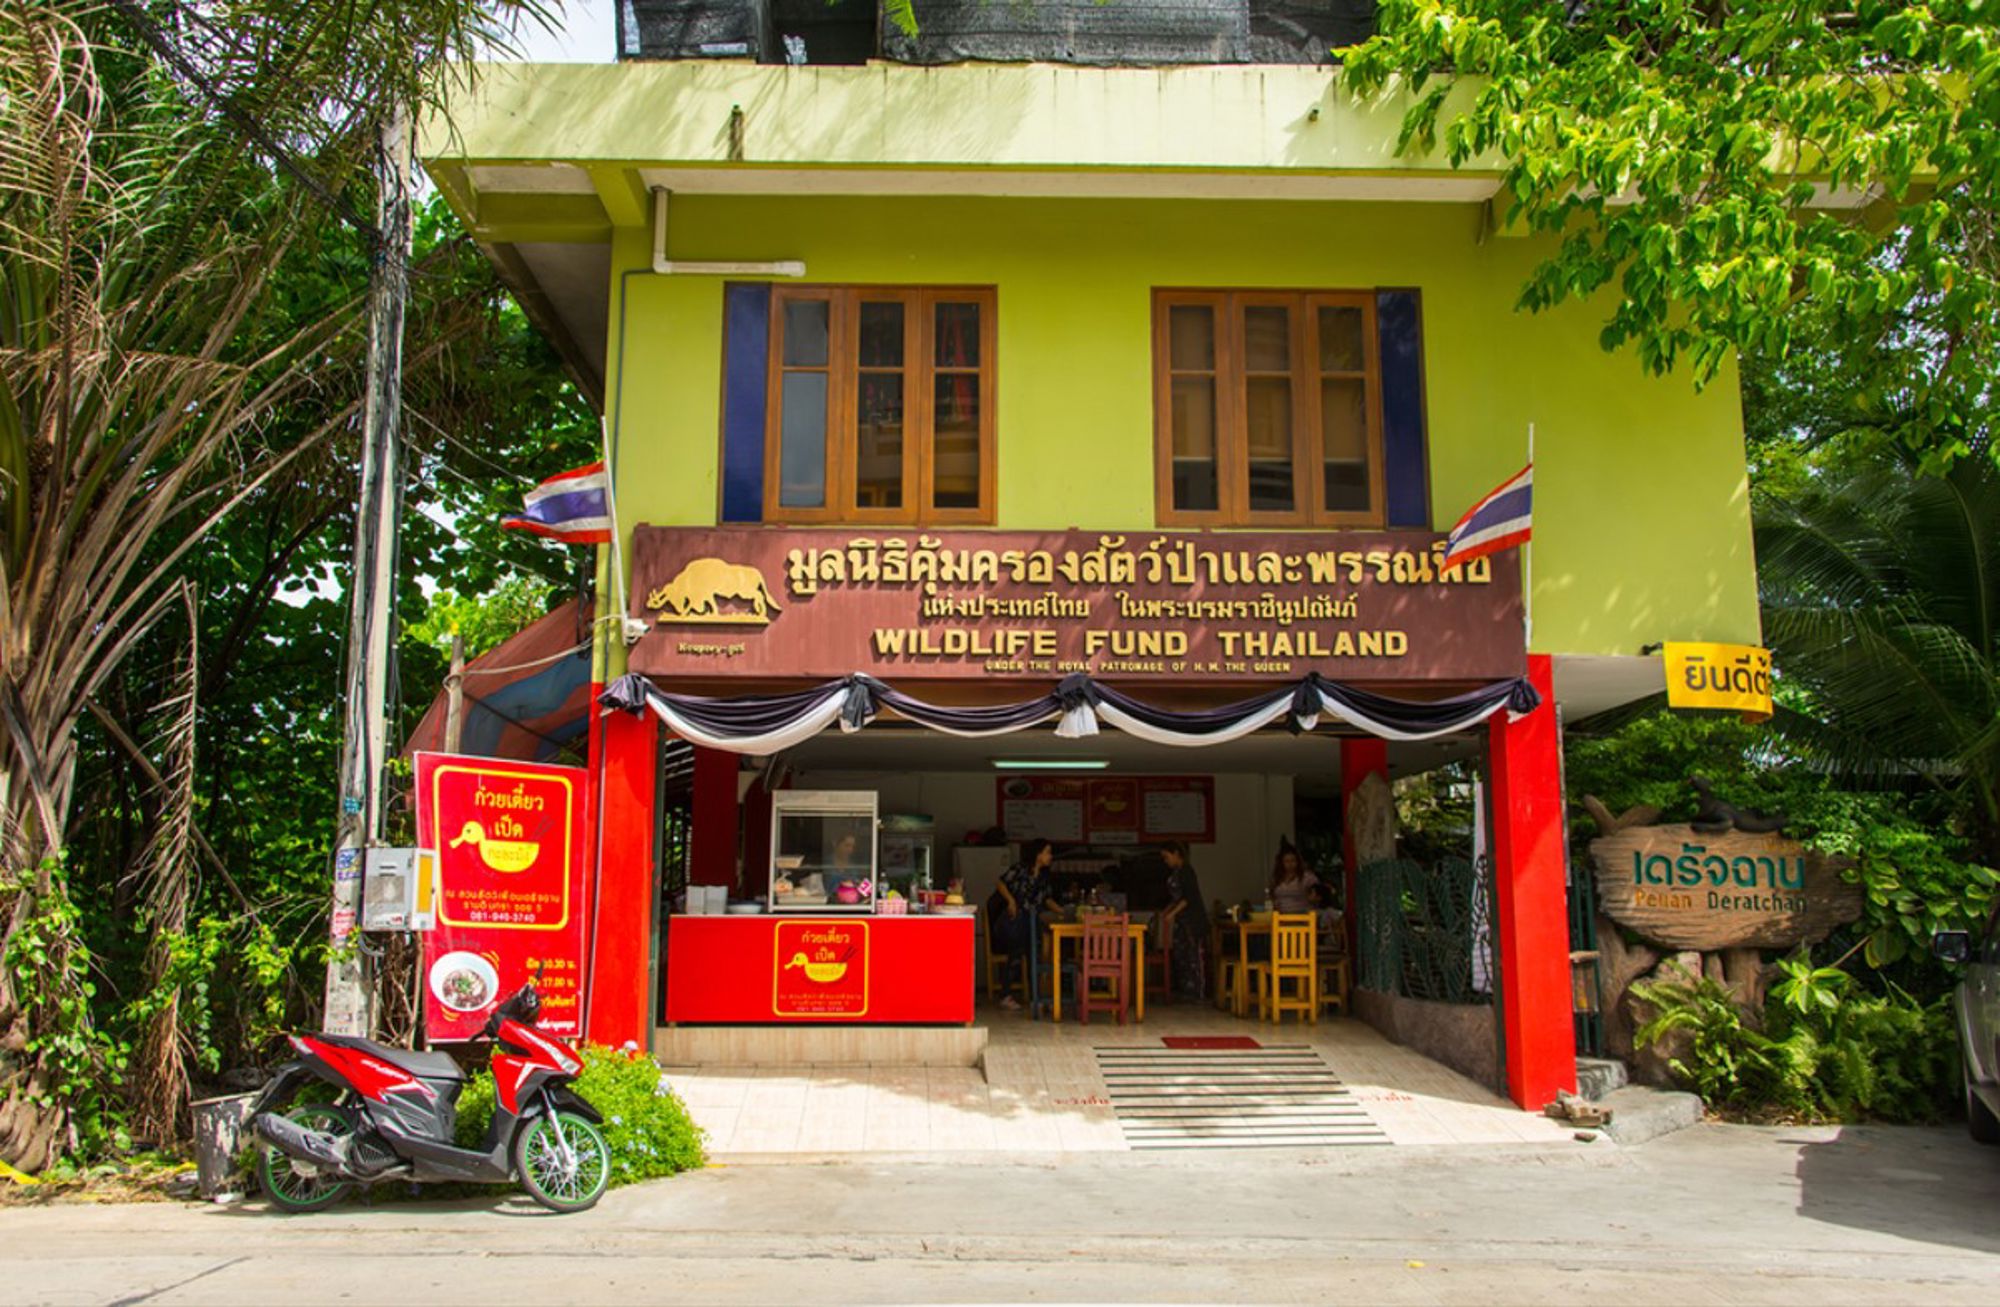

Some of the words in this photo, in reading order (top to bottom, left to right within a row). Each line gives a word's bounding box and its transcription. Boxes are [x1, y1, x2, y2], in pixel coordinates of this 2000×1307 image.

[923, 592, 1090, 618] แห่งประเทศไทย
[875, 628, 1057, 656] WILDLIFE
[1085, 629, 1188, 657] FUND
[1218, 630, 1409, 658] THAILAND
[985, 660, 1023, 671] UNDER
[1029, 660, 1050, 671] THE
[1057, 660, 1092, 671] ROYAL
[1100, 661, 1165, 672] PATRONAGE
[1171, 661, 1187, 672] OF
[1225, 662, 1246, 672] THE
[1253, 662, 1291, 672] QUEEN
[1634, 888, 1692, 909] Peuan
[1707, 891, 1807, 914] Deratchan
